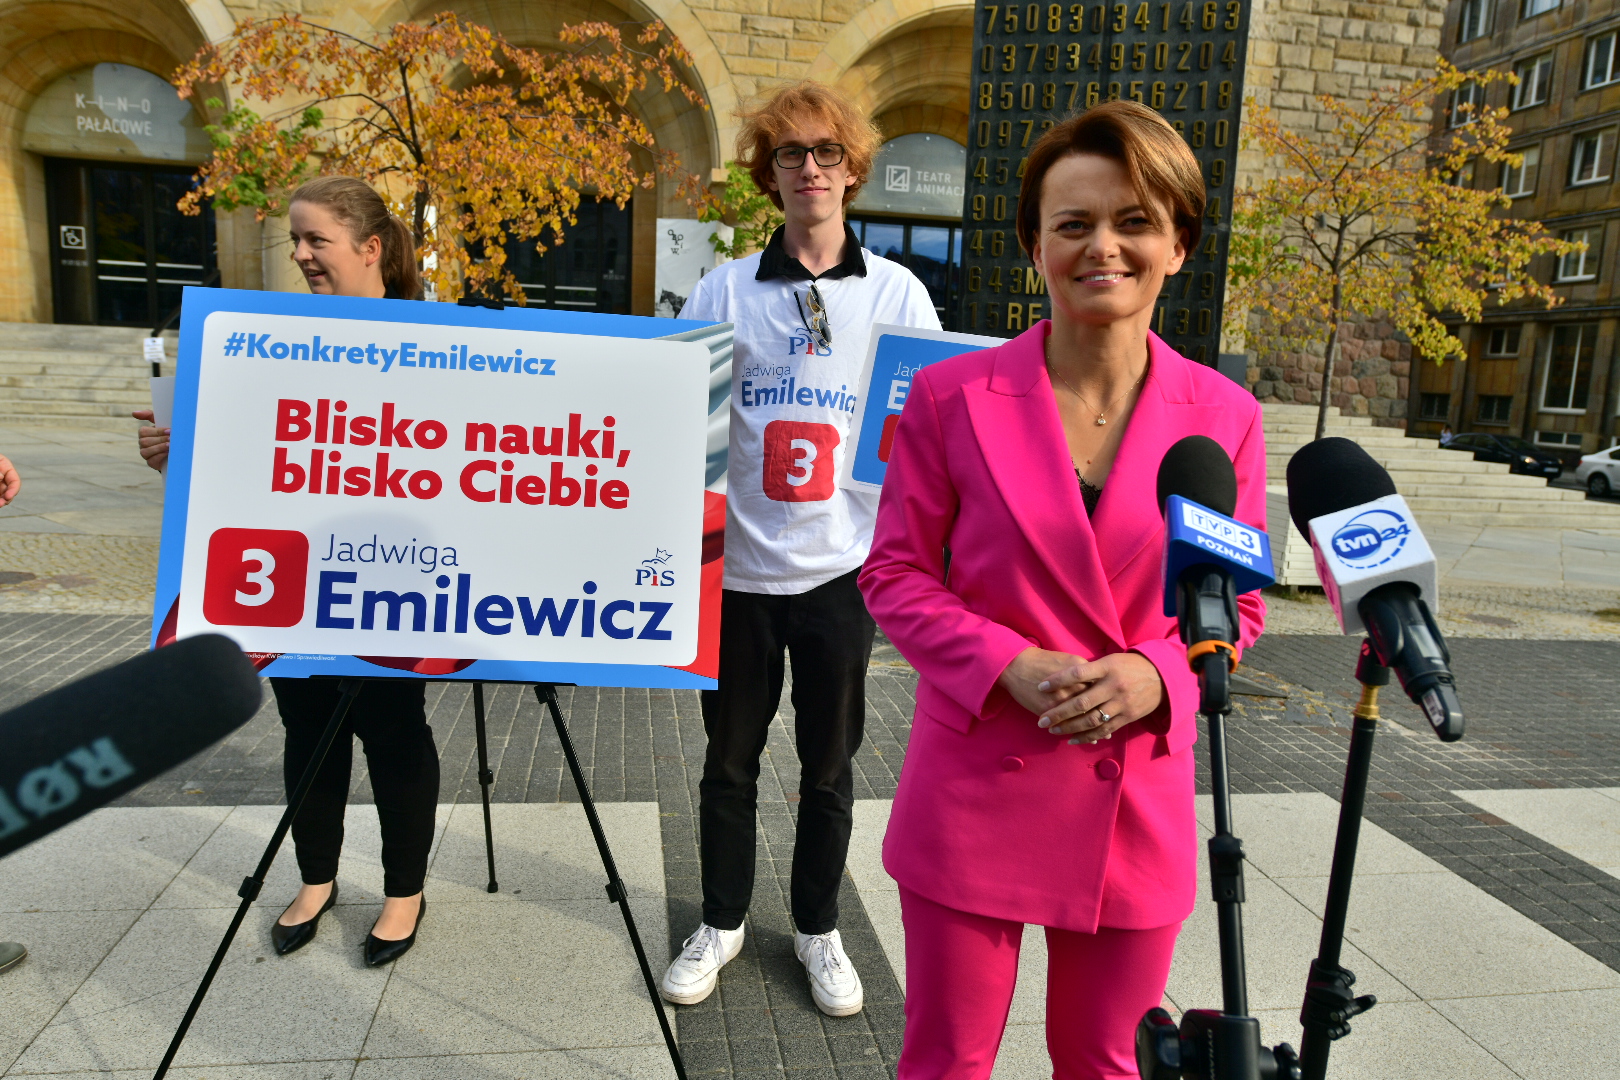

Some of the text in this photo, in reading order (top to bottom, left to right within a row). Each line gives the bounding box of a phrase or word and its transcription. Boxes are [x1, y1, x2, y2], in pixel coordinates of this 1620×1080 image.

[76, 115, 153, 137] PAŁACOWE
[915, 170, 952, 184] TEATR
[223, 331, 557, 376] #KonkretyEmilewicz
[741, 363, 792, 380] Jadwiga
[275, 398, 632, 468] Blisko nauki,
[270, 447, 631, 510] blisko Ciebie
[786, 438, 818, 487] 3
[321, 533, 459, 574] Jadwiga
[1197, 534, 1254, 566] POZNAŃ
[234, 548, 276, 607] 3
[635, 567, 675, 588] PiS
[315, 570, 674, 641] Emilewicz
